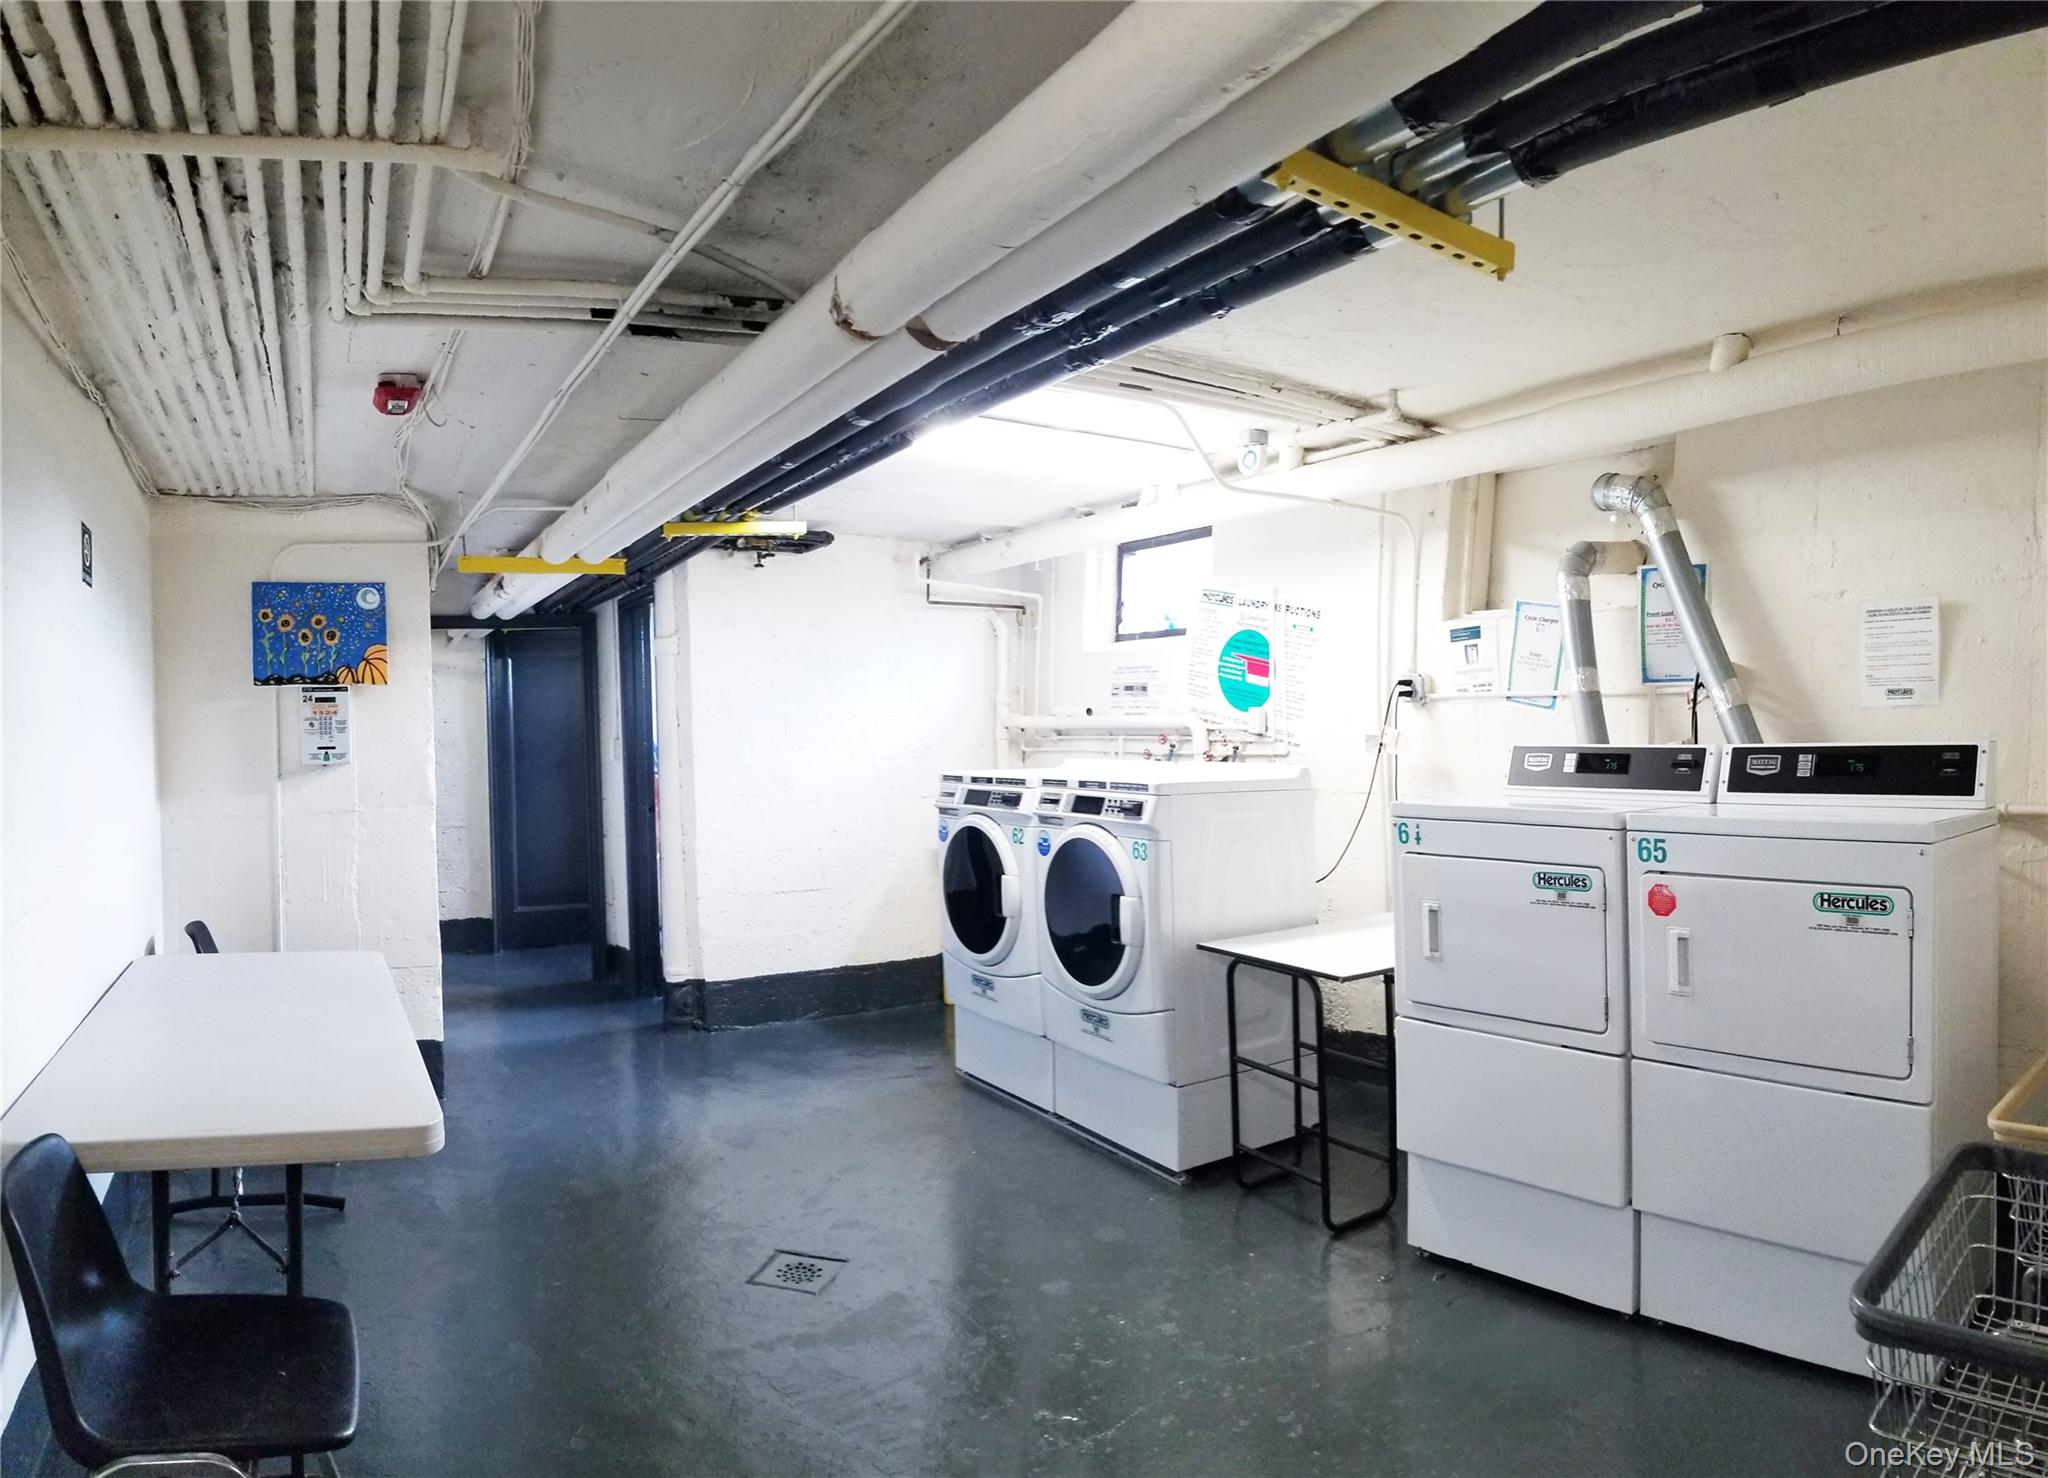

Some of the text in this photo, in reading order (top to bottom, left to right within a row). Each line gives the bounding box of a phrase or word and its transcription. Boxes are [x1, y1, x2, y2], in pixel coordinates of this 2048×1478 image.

[1524, 614, 1560, 625] Cycle Charges
[302, 695, 313, 703] 24
[1751, 758, 1777, 766] MAYTAG
[1012, 827, 1024, 845] 62
[1132, 841, 1148, 861] 63
[1637, 837, 1668, 864] 65
[1537, 872, 1588, 888] Hercules
[1820, 893, 1888, 912] Hercules
